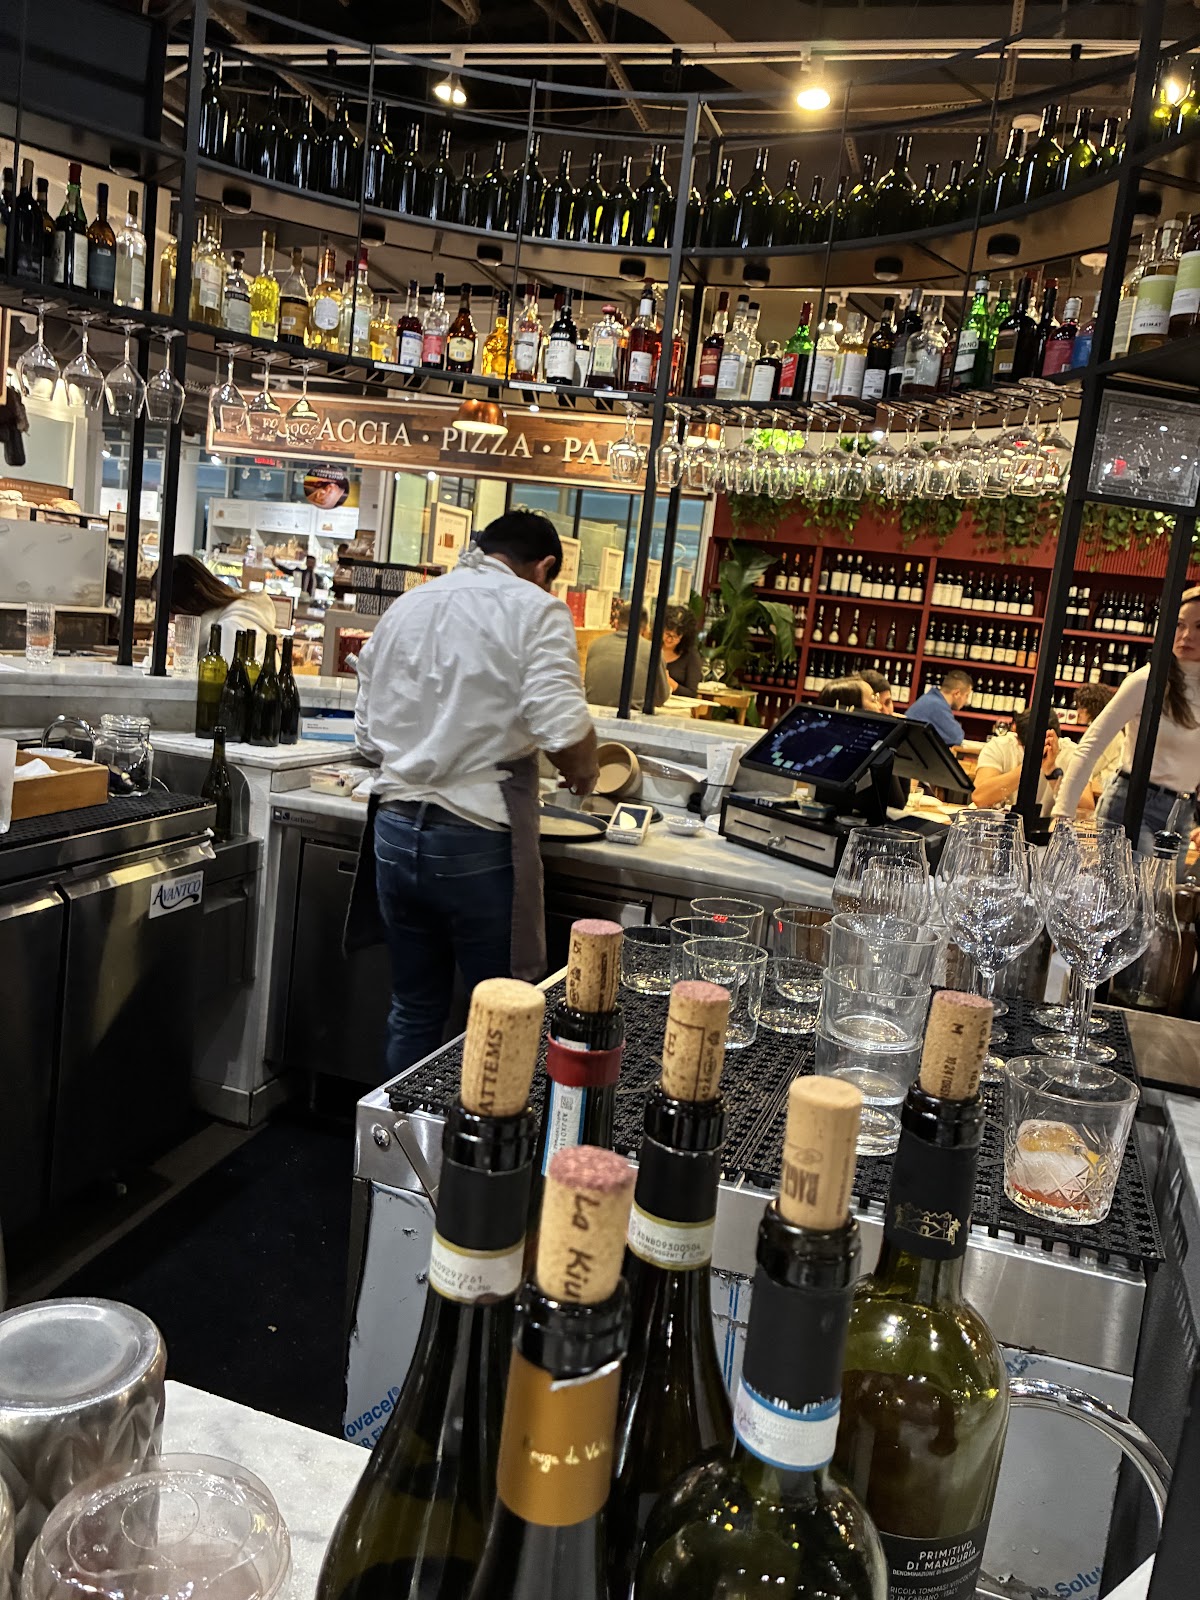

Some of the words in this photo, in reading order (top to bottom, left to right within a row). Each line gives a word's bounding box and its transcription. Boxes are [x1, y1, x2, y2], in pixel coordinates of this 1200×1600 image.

[440, 426, 533, 459] PIZZA
[152, 879, 201, 909] AVANTCO
[951, 1022, 964, 1035] M
[478, 1027, 503, 1115] ATTEMS
[572, 1193, 602, 1231] La
[563, 1246, 596, 1299] Kiu
[906, 1561, 920, 1571] DI
[924, 1546, 977, 1571] MANDURIA
[919, 1540, 973, 1561] PRIMITIVO
[890, 1585, 917, 1595] RICOLA
[918, 1583, 950, 1595] TOMMASI
